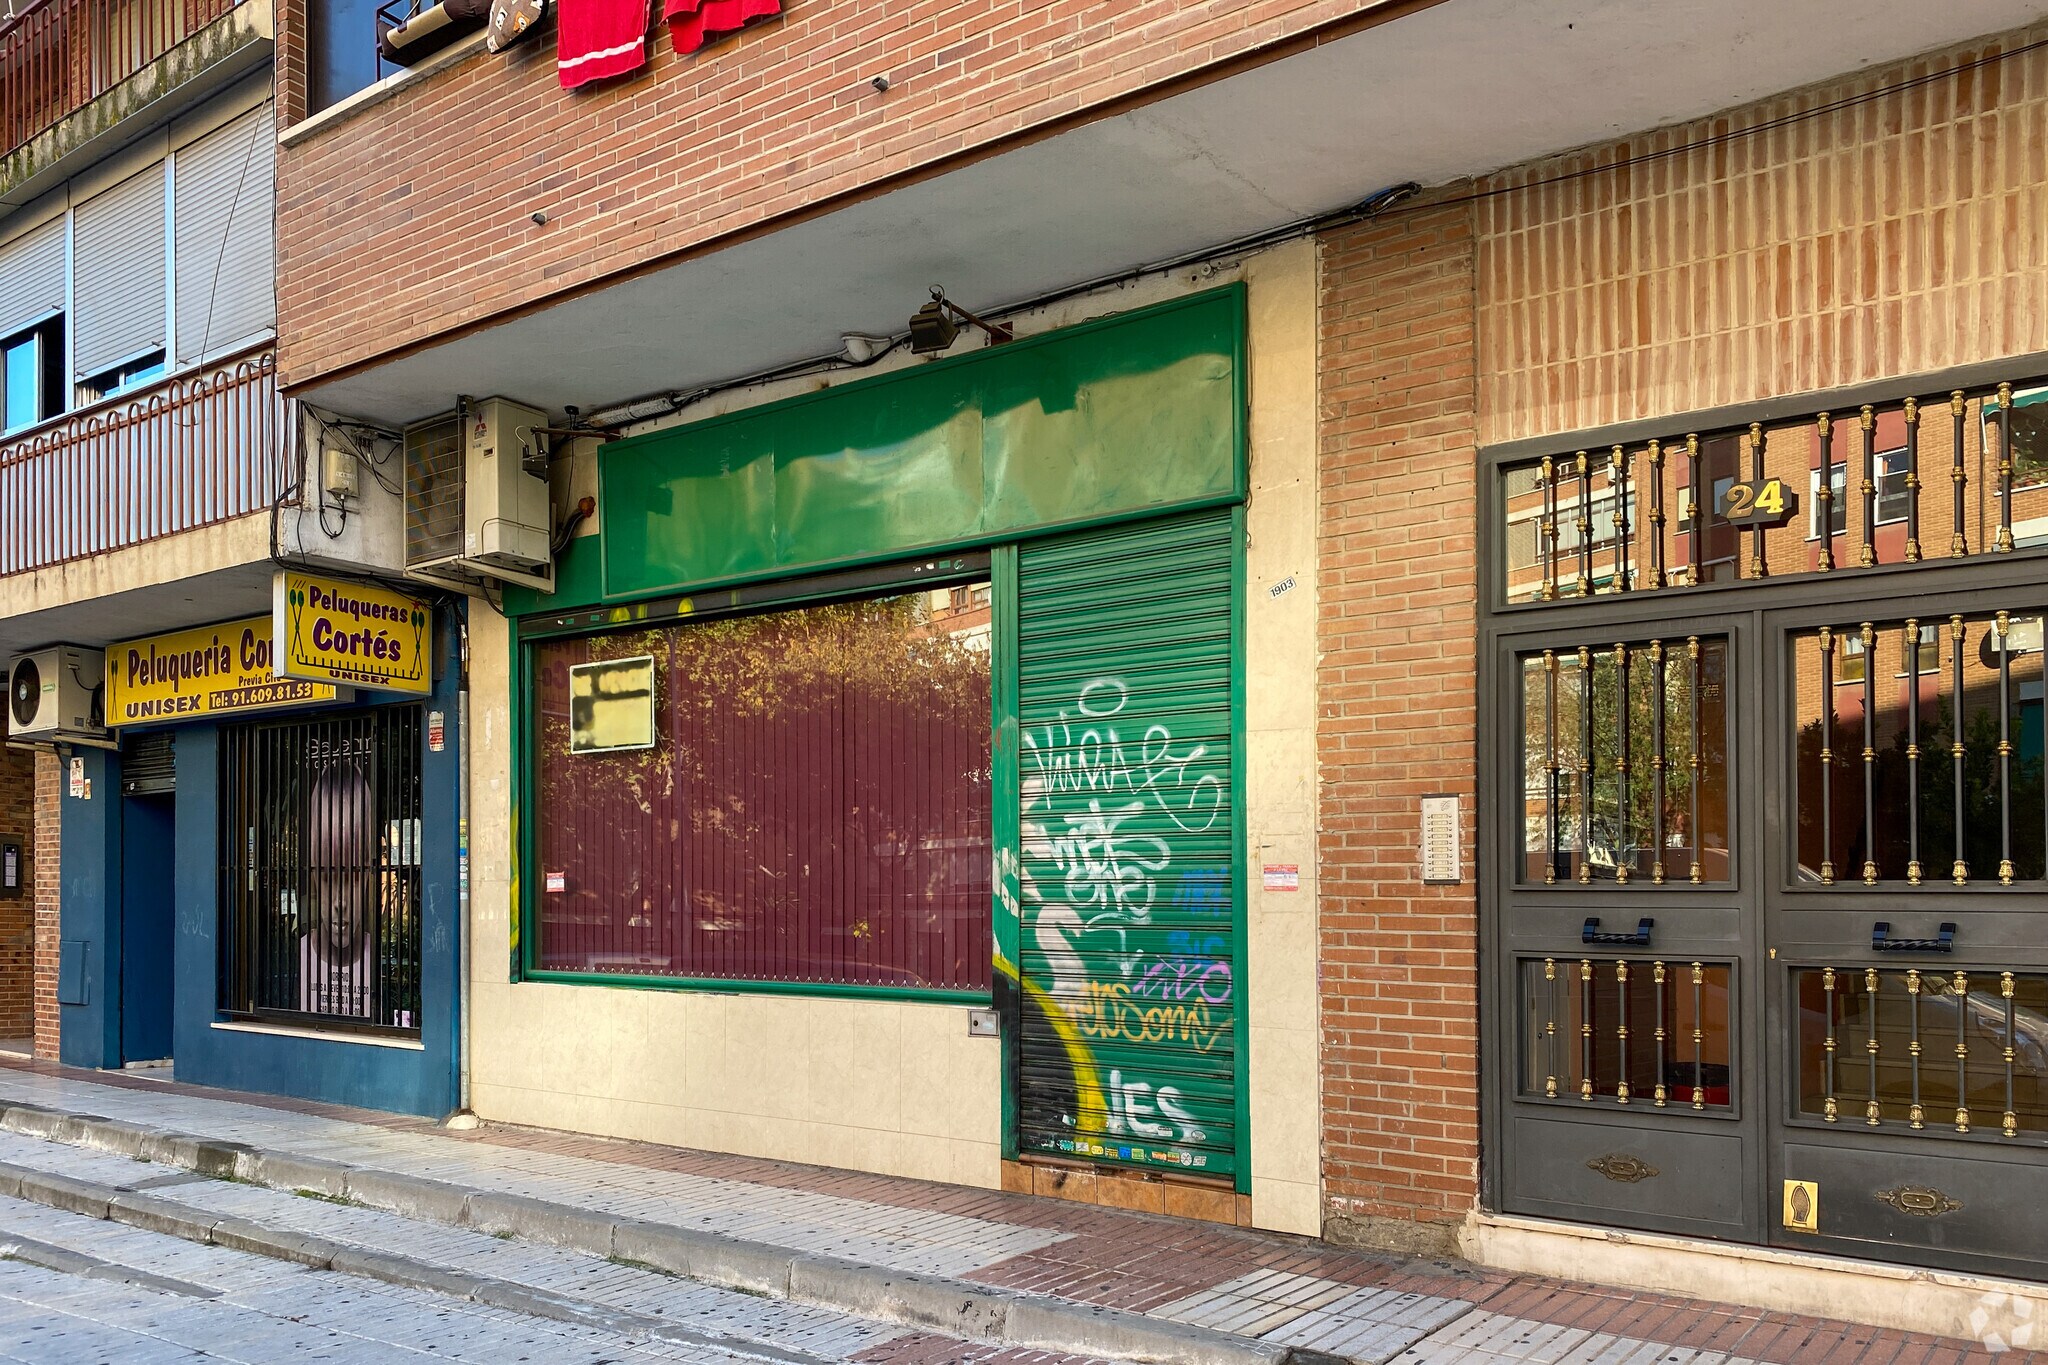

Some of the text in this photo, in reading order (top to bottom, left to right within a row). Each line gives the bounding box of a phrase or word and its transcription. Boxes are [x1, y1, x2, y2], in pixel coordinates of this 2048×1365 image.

[1726, 480, 1784, 519] 24
[1270, 578, 1294, 597] 1903
[309, 585, 408, 624] Peluqueras
[312, 617, 401, 662] Cortés
[128, 634, 231, 693] Peluqueria
[238, 674, 262, 687] Previa
[329, 669, 390, 685] UNISEX
[126, 693, 202, 718] UNISEX
[210, 682, 312, 708] Tel: 91.609.81.53
